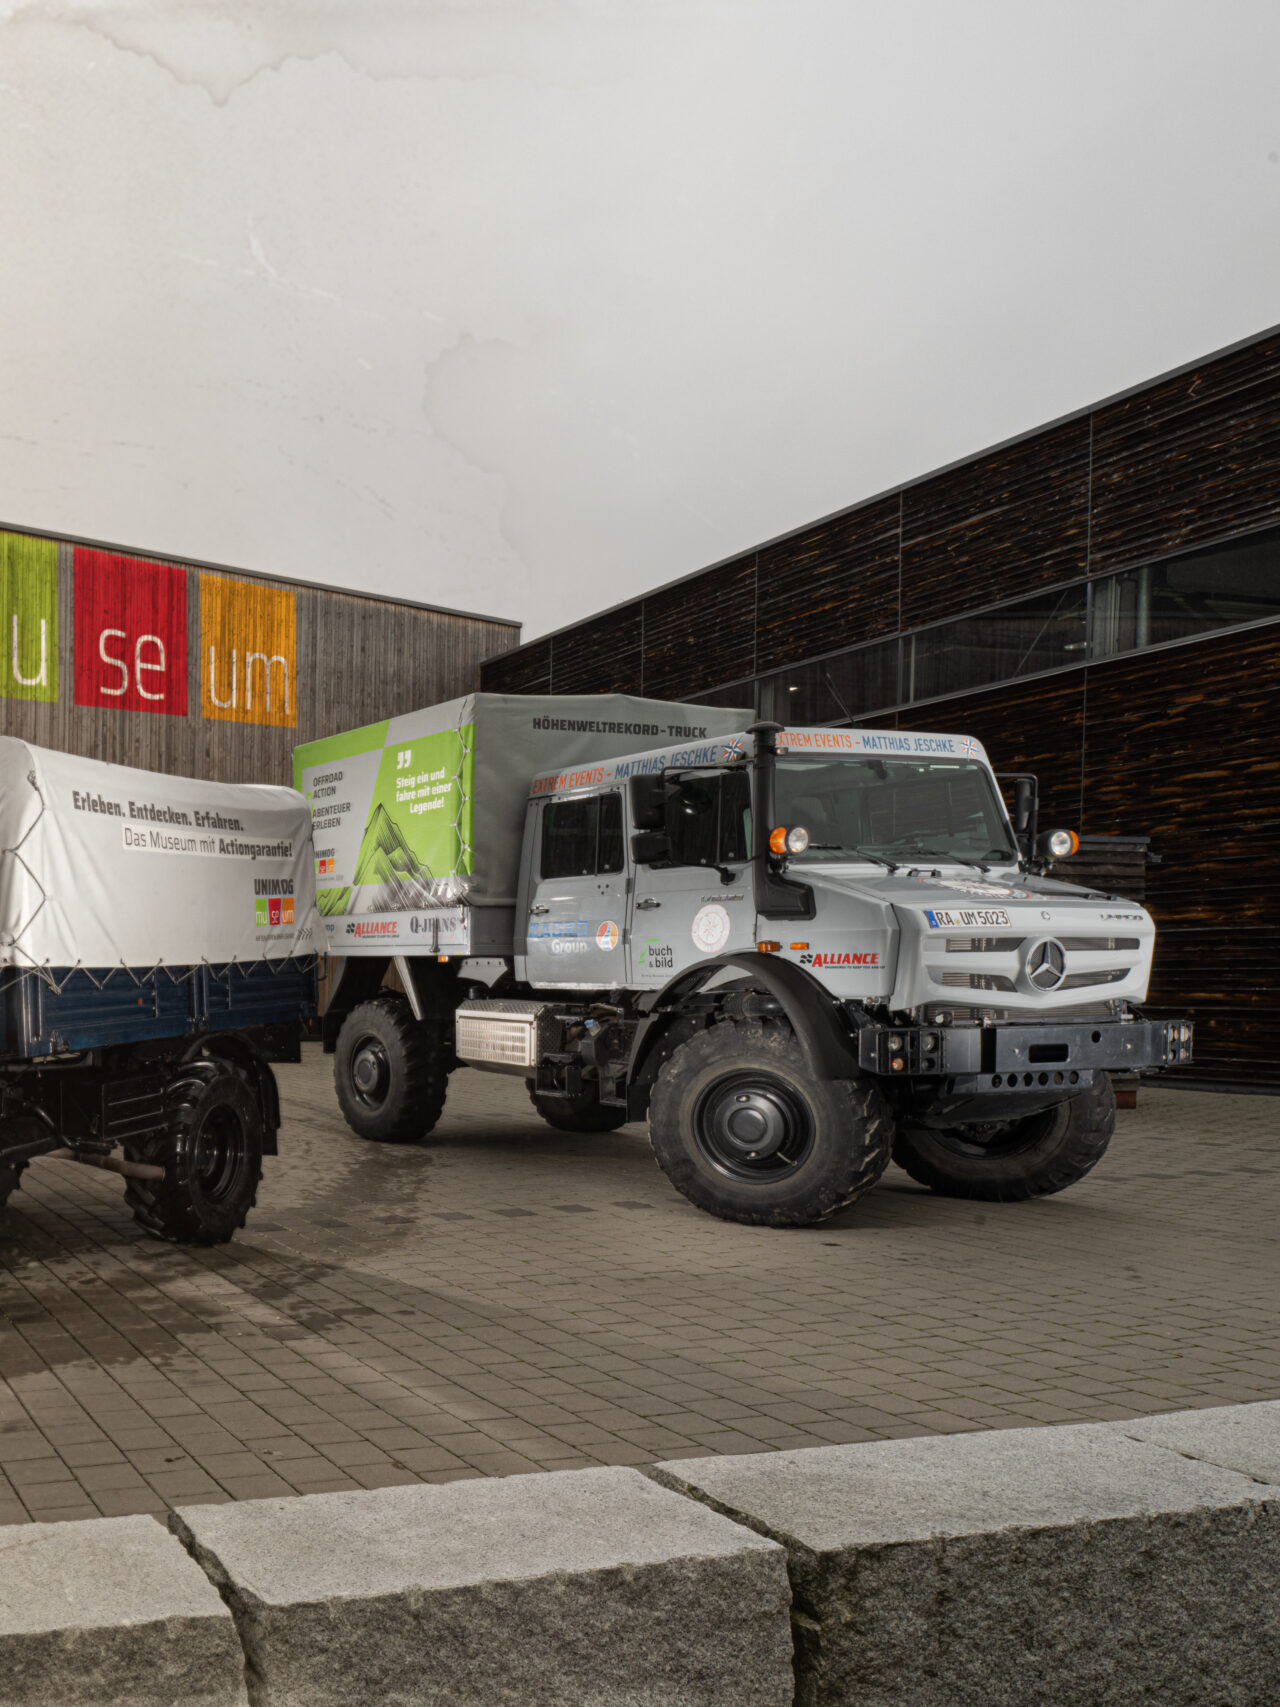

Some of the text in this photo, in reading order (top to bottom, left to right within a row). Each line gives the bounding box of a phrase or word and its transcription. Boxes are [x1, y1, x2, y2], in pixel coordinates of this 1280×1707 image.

[814, 734, 853, 748] EVENTS
[862, 736, 911, 751] MATTHIAS
[913, 738, 956, 753] JESCHKE
[313, 771, 344, 787] OFFROAD
[396, 766, 445, 788] Steig ein und
[532, 774, 567, 794] EXTREM
[569, 767, 605, 788] EVENTS
[614, 754, 666, 779] MATTHIAS
[313, 786, 336, 799] ACTION
[396, 782, 452, 802] fahre mit einer
[72, 790, 244, 832] Erleben. Entdecken. Erfahren.
[313, 802, 351, 817] ABENTEUER
[410, 796, 445, 815] Legende!
[312, 817, 341, 831] ERLEBEN
[124, 828, 293, 861] Das Museum mit Actiongarantie!
[314, 848, 335, 859] NIMOG
[254, 878, 295, 896] UNIMOG
[936, 911, 955, 926] RA
[982, 910, 1009, 926] 5023
[354, 921, 398, 938] ALLIANCE
[528, 921, 589, 938] ZAGRO
[551, 939, 588, 954] Group
[648, 945, 673, 957] buch
[655, 957, 673, 968] bild
[811, 953, 881, 968] ALLIANCE
